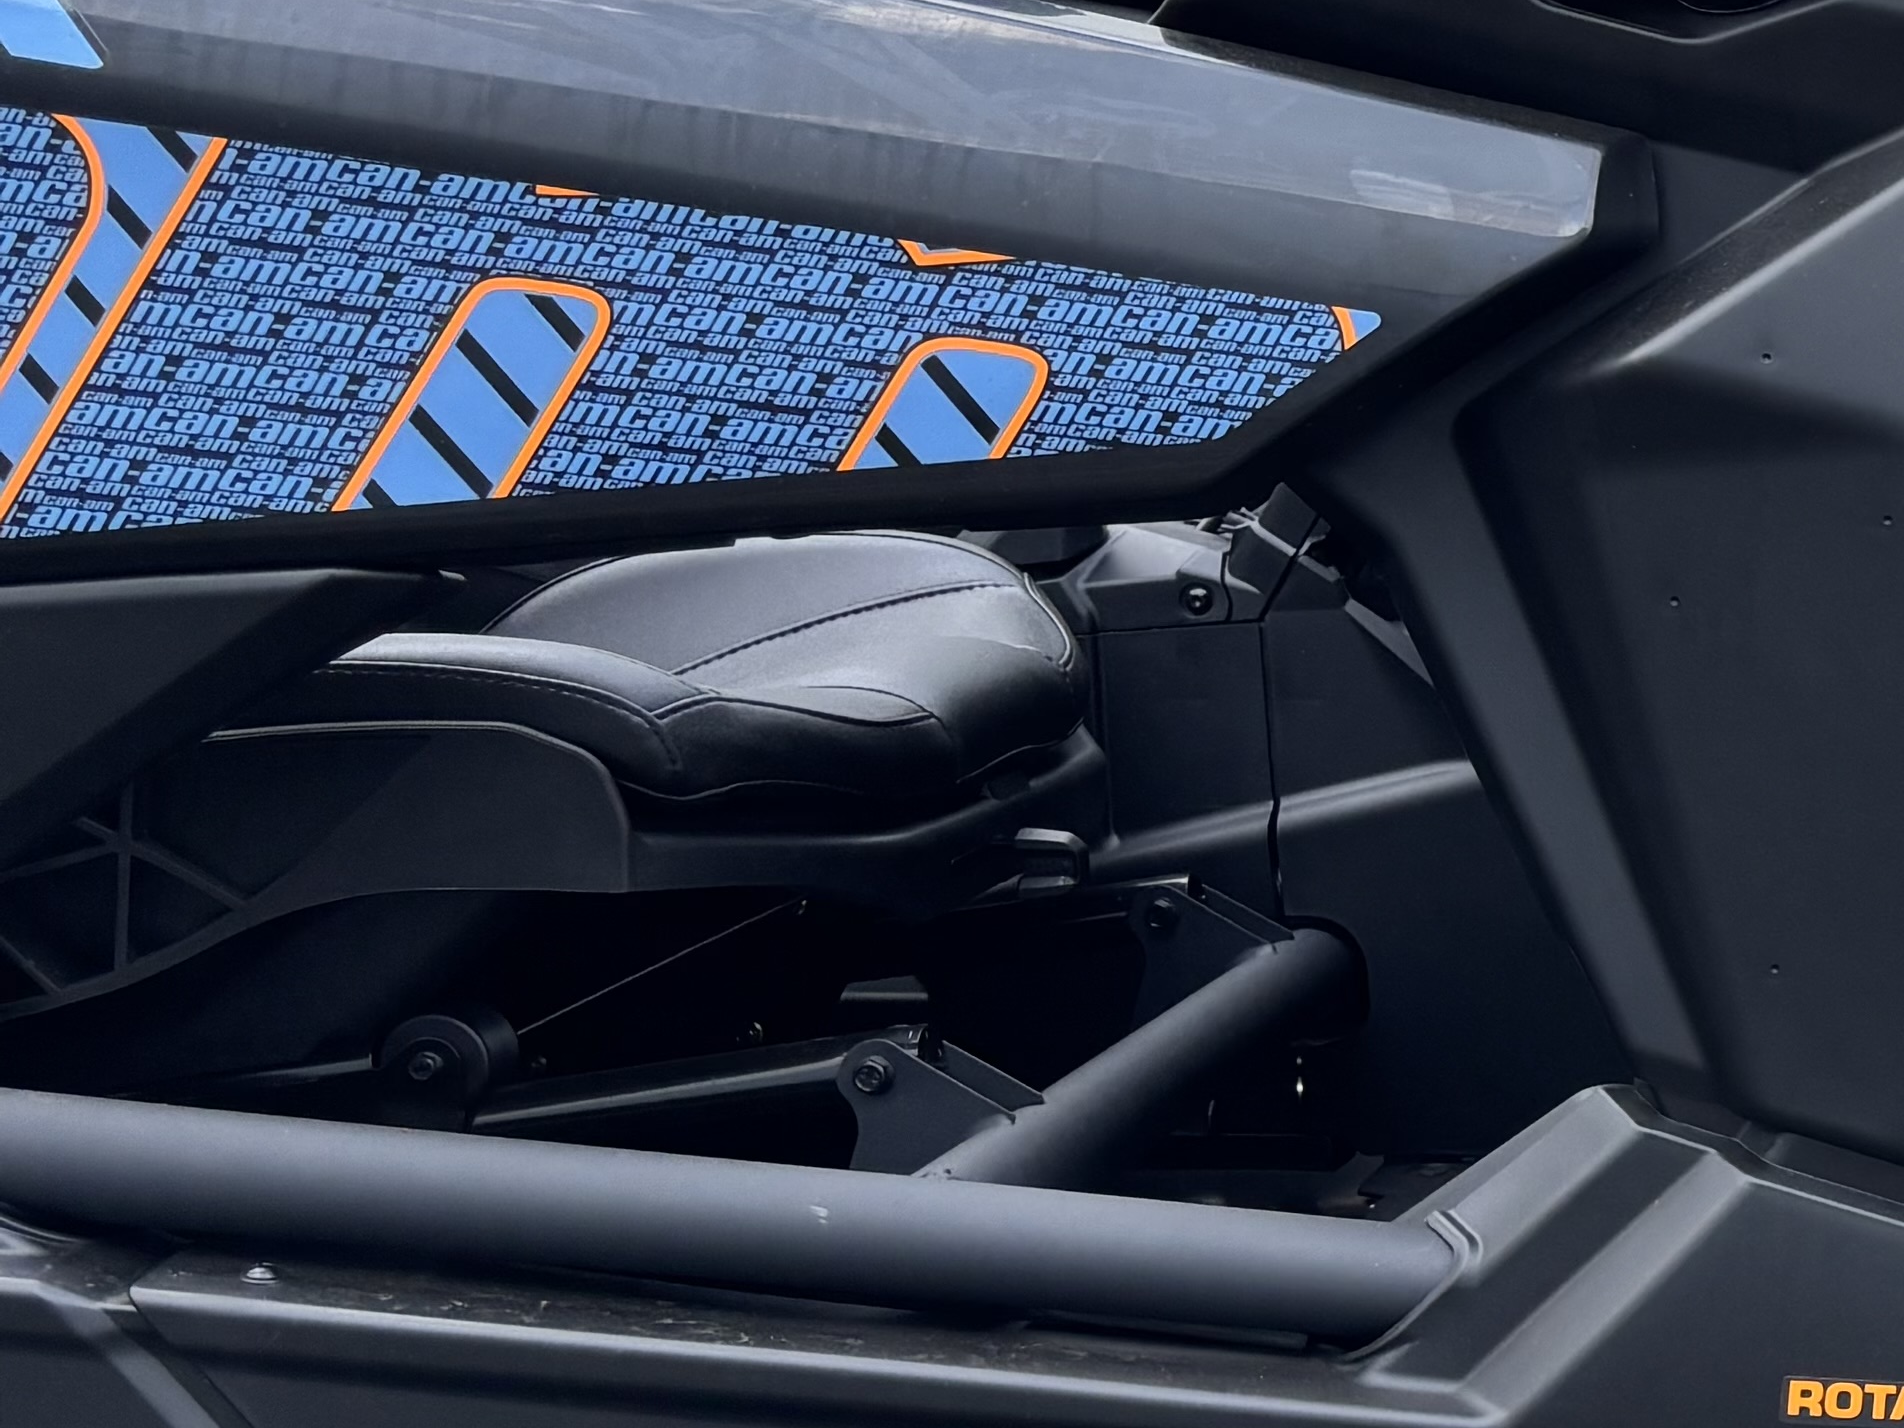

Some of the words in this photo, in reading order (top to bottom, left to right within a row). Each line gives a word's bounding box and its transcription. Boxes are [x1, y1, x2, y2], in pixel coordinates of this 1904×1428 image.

[327, 157, 510, 205] can-am
[318, 178, 420, 207] can-am
[500, 199, 602, 229] can-am
[682, 222, 780, 250] can-am
[230, 181, 335, 212] can-am
[413, 203, 518, 234] can-am
[594, 224, 699, 255] can-am
[774, 246, 875, 275] can-am
[952, 268, 1053, 298] can-am
[1125, 288, 1223, 316] can-am
[302, 243, 408, 274] can-am
[158, 247, 290, 287] n-am
[218, 198, 401, 245] can-am
[400, 220, 584, 267] can-am
[584, 241, 760, 287] can-am
[762, 262, 938, 307] can-am
[938, 284, 1114, 329] can-am
[1111, 303, 1283, 348] can-am
[1033, 264, 1131, 293] can-am
[193, 285, 298, 316] can-am
[209, 219, 311, 248] can-am
[392, 241, 494, 270] can-am
[573, 261, 674, 290] can-am
[753, 282, 851, 310] can-am
[930, 304, 1028, 332] can-am
[1102, 323, 1199, 351] can-am
[281, 281, 383, 310] can-am
[172, 323, 273, 352] can-am
[180, 301, 364, 349] can-am
[647, 322, 744, 350] can-am
[656, 302, 832, 347] can-am
[668, 285, 769, 315] can-am
[845, 305, 946, 335] can-am
[1019, 327, 1120, 356] can-am
[1191, 348, 1289, 376] can-am
[101, 347, 255, 391] an-am
[255, 362, 405, 406] can-a
[267, 346, 373, 377] can-am
[593, 348, 725, 388] n-am
[738, 345, 839, 375] can-am
[1043, 349, 1181, 388] an-am
[157, 388, 263, 419] can-am
[246, 384, 348, 413] can-am
[632, 387, 733, 417] can-am
[717, 382, 815, 410] can-am
[1088, 386, 1186, 414] can-am
[1169, 383, 1266, 410] can-am
[136, 426, 238, 455] can-am
[145, 404, 328, 452] can-am
[611, 424, 709, 452] can-am
[620, 403, 796, 449] can-am
[1065, 420, 1163, 448] can-am
[36, 448, 219, 495] can-am
[48, 432, 154, 462] can-am
[231, 449, 337, 480] can-am
[538, 447, 687, 489] an-am
[27, 469, 129, 499] can-am
[210, 486, 312, 516] can-am
[121, 491, 227, 522] can-am
